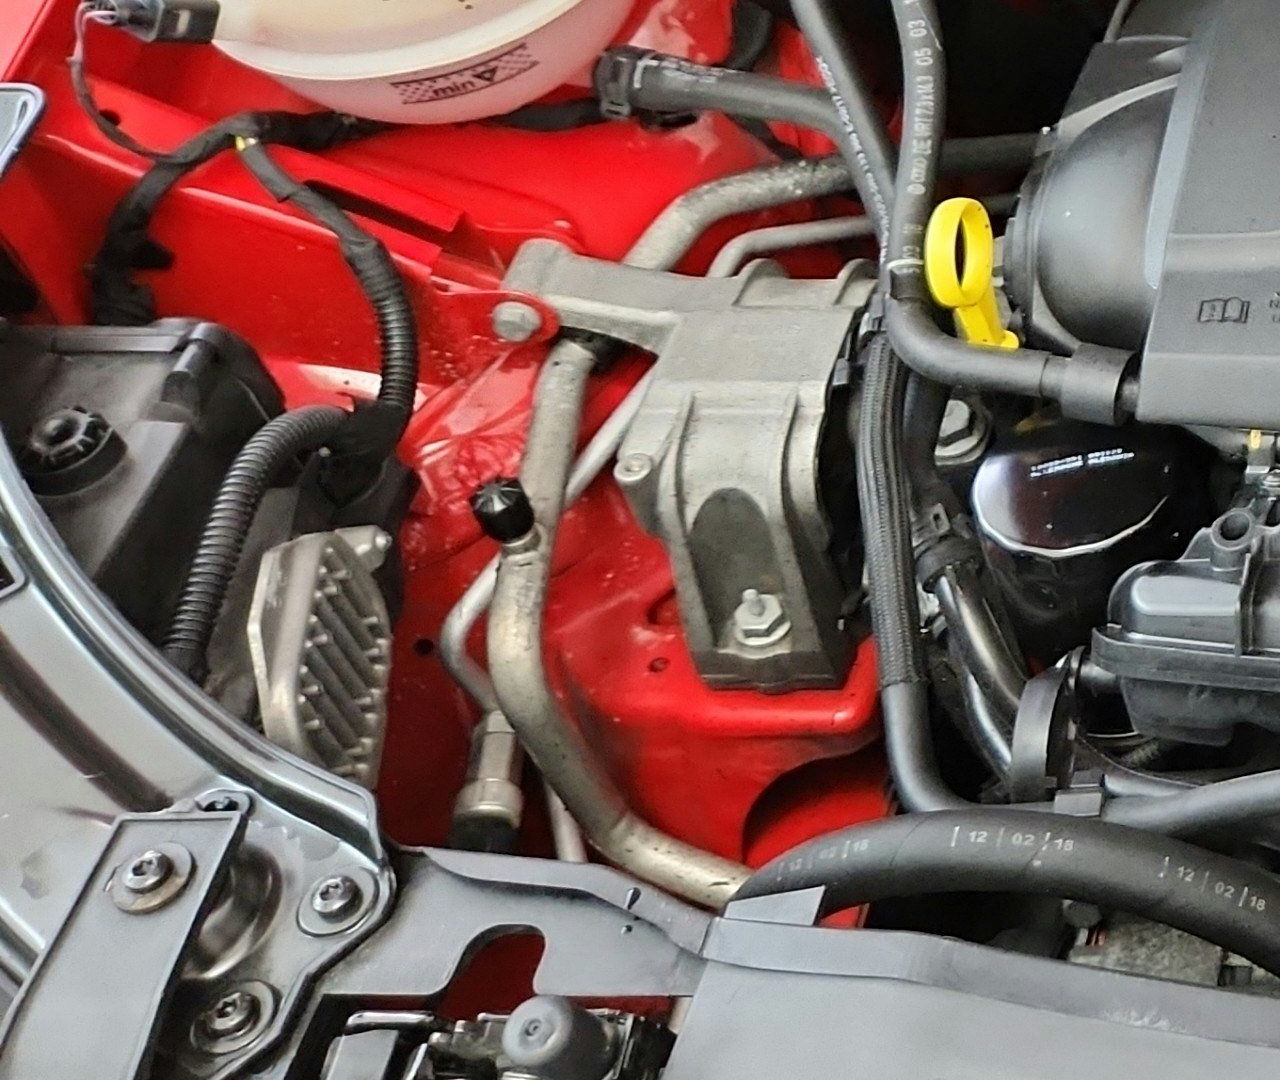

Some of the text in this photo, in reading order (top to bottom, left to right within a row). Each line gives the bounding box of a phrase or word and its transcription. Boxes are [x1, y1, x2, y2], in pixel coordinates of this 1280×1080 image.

[907, 19, 927, 38] 03
[912, 47, 934, 67] 05
[432, 78, 475, 98] min
[968, 831, 1075, 851] 12 02 18
[1177, 865, 1267, 911] 12 02 18
